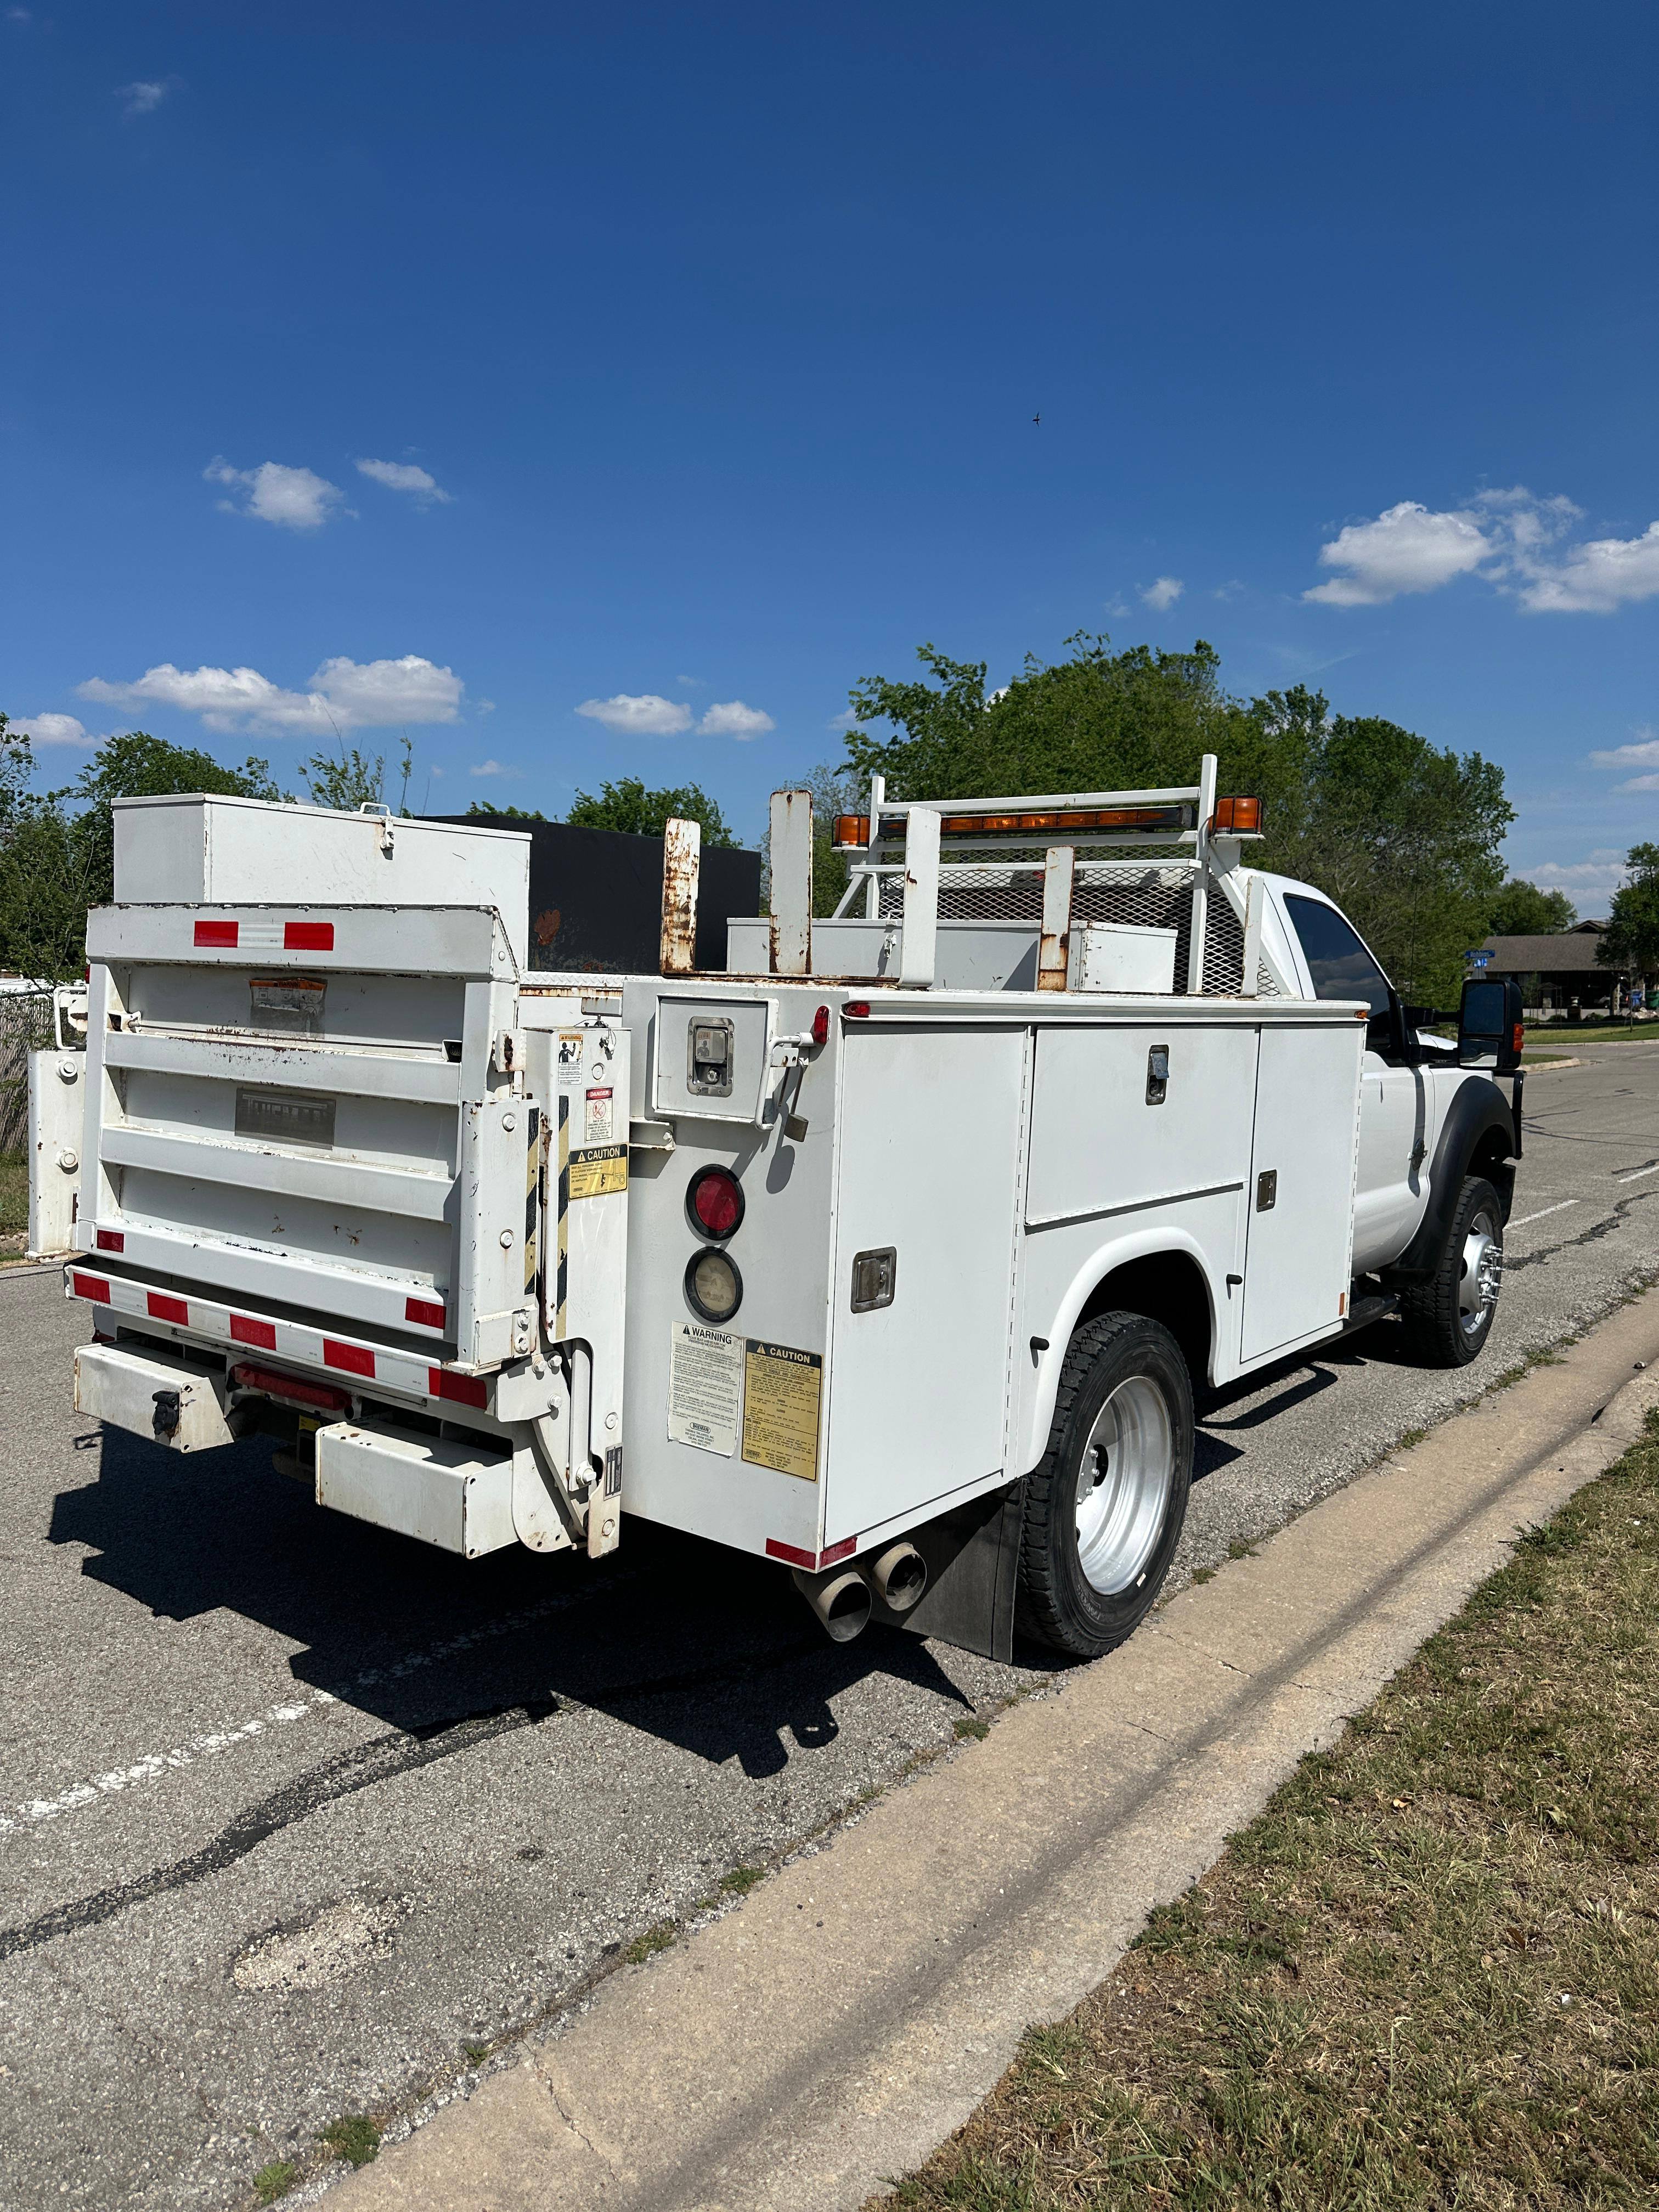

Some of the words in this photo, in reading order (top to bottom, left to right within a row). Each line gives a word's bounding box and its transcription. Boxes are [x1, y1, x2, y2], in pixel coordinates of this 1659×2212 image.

[587, 1147, 620, 1160] CAUTION
[692, 1327, 732, 1345] WARNING
[770, 1347, 810, 1364] CAUTION
